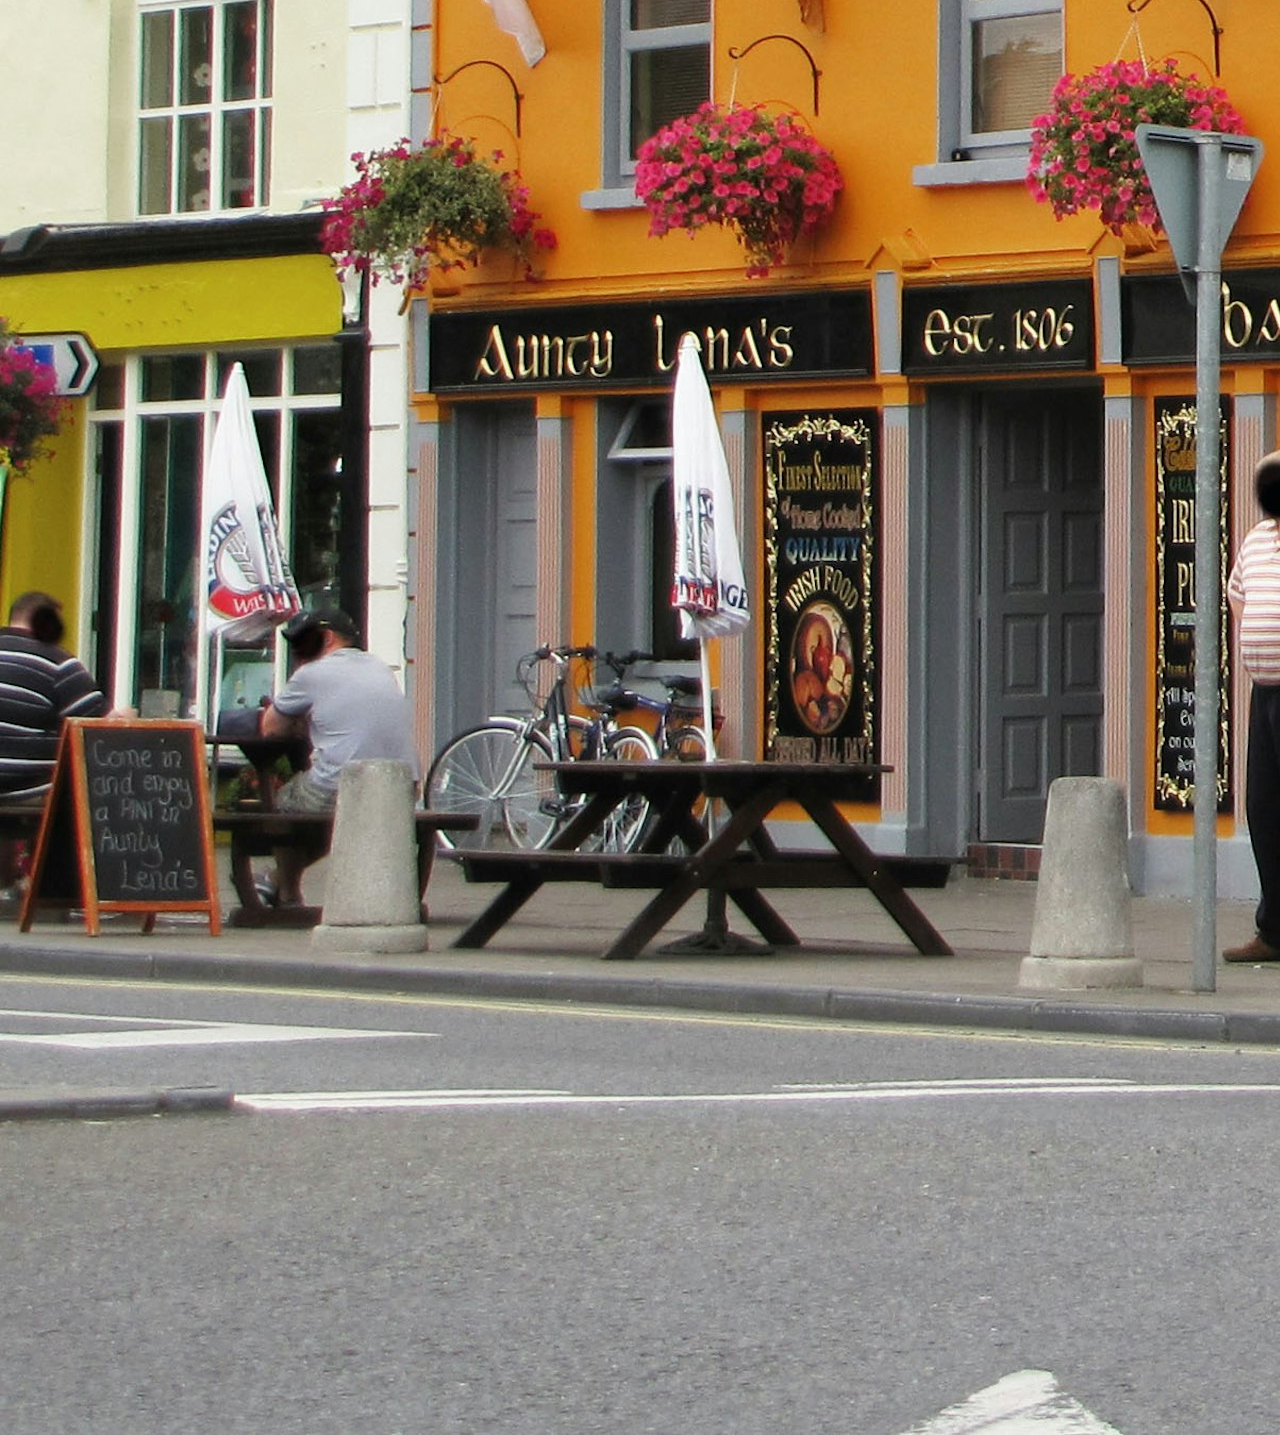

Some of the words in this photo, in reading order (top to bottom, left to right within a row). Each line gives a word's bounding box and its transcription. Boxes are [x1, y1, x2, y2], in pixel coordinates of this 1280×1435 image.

[1013, 304, 1075, 351] 1806
[474, 323, 614, 381] Aunty
[823, 501, 860, 532] Cooked
[1172, 499, 1196, 544] IRI
[785, 536, 860, 565] QUALITY
[785, 565, 821, 612] IRISH
[823, 565, 859, 610] FOOD
[93, 739, 151, 767] Come
[160, 738, 183, 768] in
[820, 737, 841, 764] ALL
[844, 737, 868, 764] DAY
[93, 769, 135, 795] and
[143, 775, 193, 810] enjoy
[95, 805, 109, 821] a
[120, 798, 155, 820] PINT
[160, 807, 180, 824] in
[100, 823, 164, 868] Aunty
[120, 859, 198, 891] Lena's
